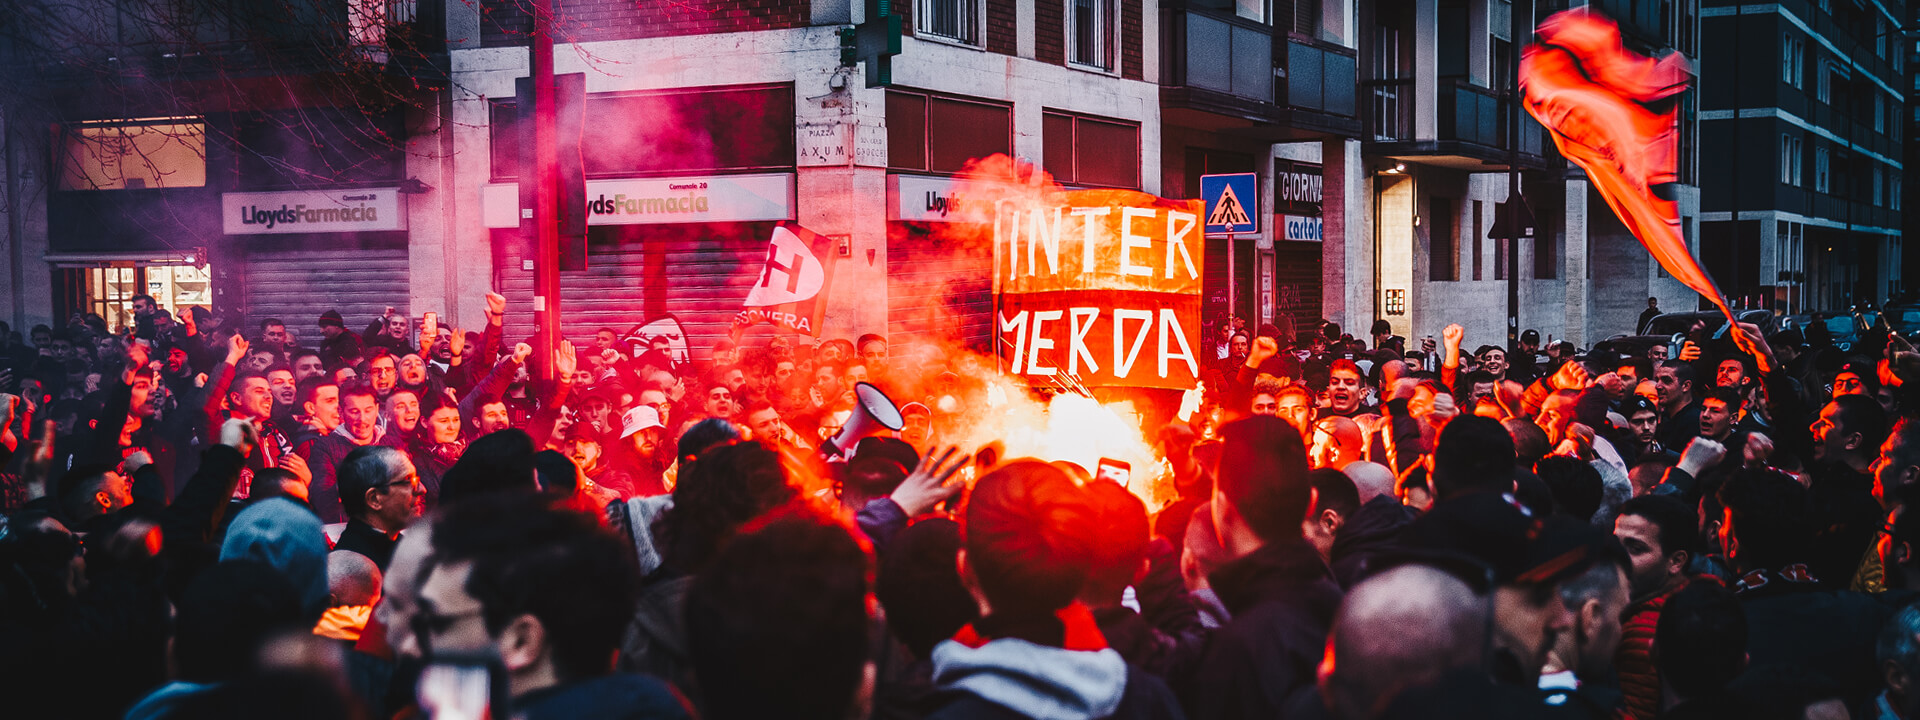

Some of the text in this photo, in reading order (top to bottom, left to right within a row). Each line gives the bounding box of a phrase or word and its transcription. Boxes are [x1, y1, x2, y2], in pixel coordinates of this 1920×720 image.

[800, 146, 845, 157] AXUM
[241, 203, 378, 229] LloydsFarmacia
[760, 243, 804, 295] H
[1010, 206, 1199, 281] INTER
[998, 307, 1199, 379] MERDA
